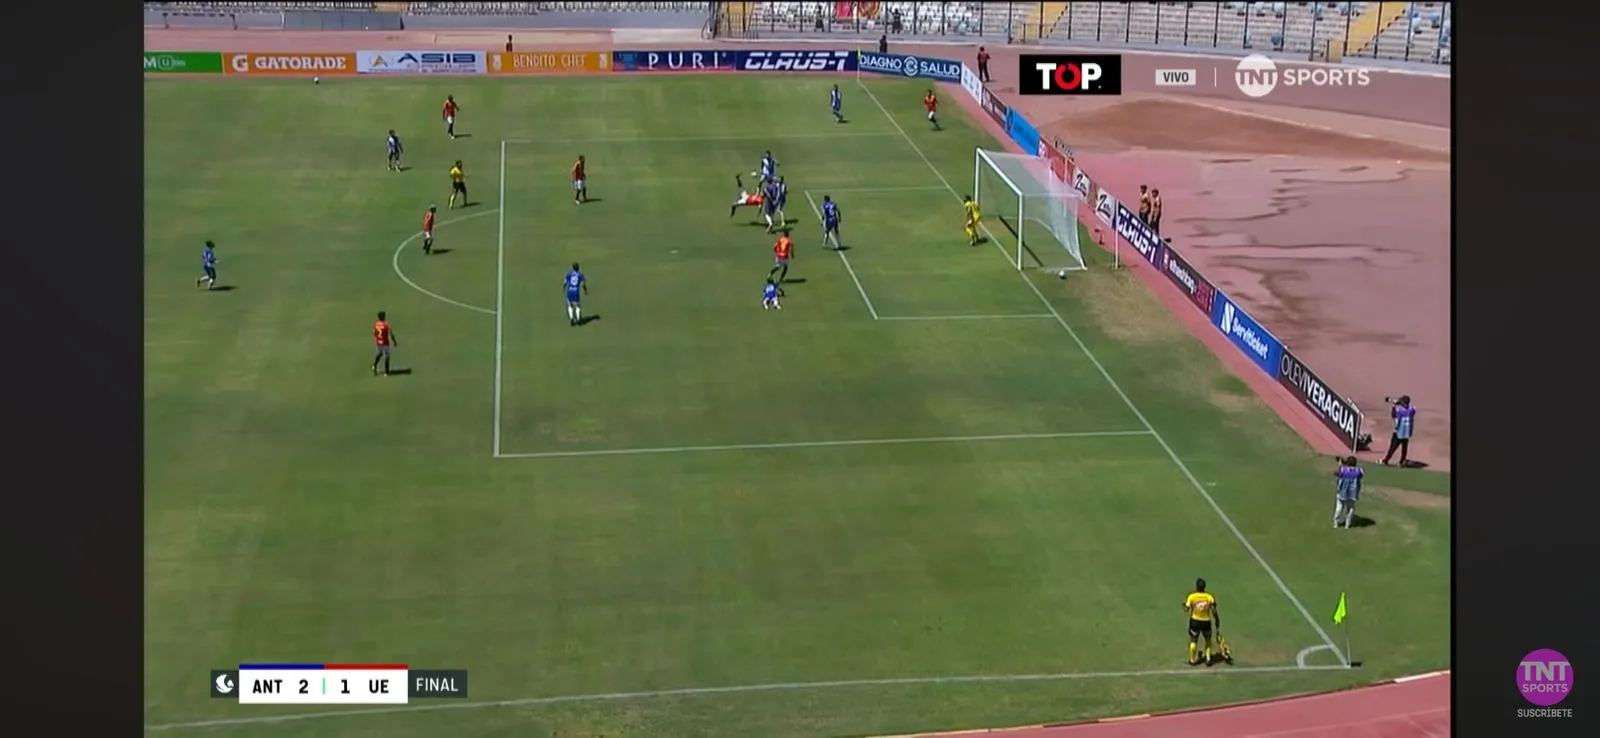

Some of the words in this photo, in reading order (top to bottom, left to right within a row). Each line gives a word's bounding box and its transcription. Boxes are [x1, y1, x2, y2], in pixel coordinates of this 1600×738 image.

[232, 54, 249, 72] G
[255, 56, 346, 69] GATORADE
[513, 54, 556, 67] BENDITO
[561, 54, 586, 67] CHEF
[859, 54, 902, 69] DIAGNO
[920, 61, 960, 76] SALUD
